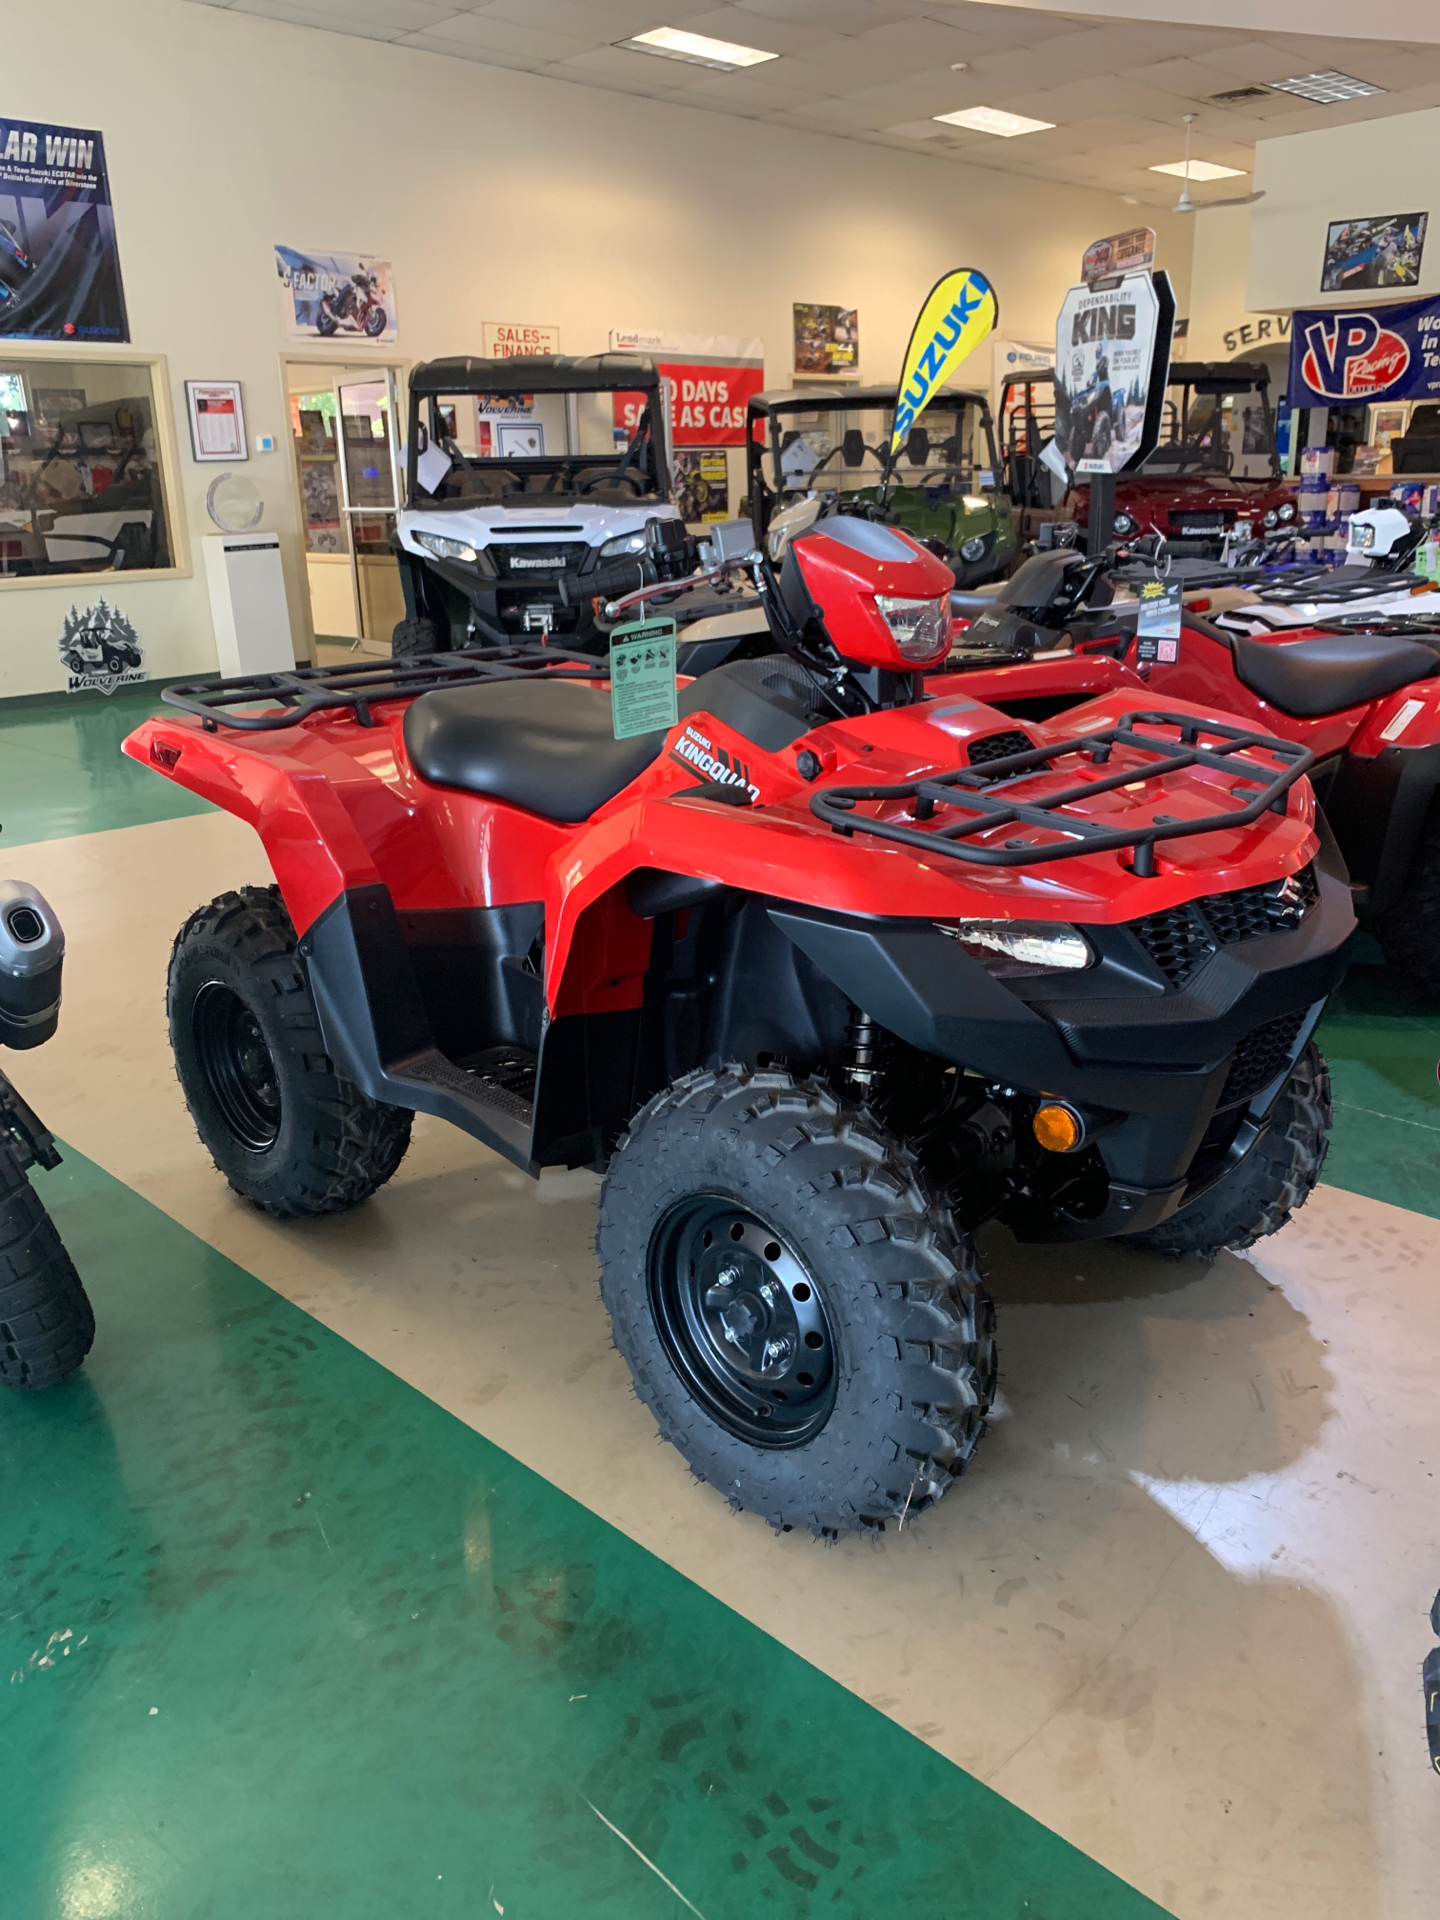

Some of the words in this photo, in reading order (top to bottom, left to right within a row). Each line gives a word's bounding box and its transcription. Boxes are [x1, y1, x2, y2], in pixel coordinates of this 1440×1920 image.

[45, 135, 94, 170] WIN
[3, 172, 24, 182] British
[24, 175, 43, 184] Grand
[43, 177, 57, 185] Prix
[65, 179, 97, 189] Silverstone
[30, 168, 51, 177] Suzuki
[51, 170, 76, 179] ECSTAR
[1078, 292, 1133, 310] DEPENDABILITY
[77, 325, 120, 336] SUZUKI
[1071, 304, 1136, 347] KING
[616, 332, 661, 344] Lendmark
[1421, 334, 1438, 350] in
[493, 343, 551, 359] FINANCE
[894, 272, 990, 440] SUZUKI
[1018, 352, 1051, 363] POLARIS
[1304, 313, 1380, 398] VP
[1349, 352, 1401, 385] Racing
[682, 379, 729, 403] DAYS
[1350, 382, 1388, 393] FUELS
[680, 405, 706, 428] AS
[1182, 525, 1224, 535] Kawasaki
[510, 556, 566, 569] Kawasaki
[630, 628, 663, 640] WARNING
[69, 672, 146, 689] WOLVERINE
[686, 726, 712, 750] SUZUKI
